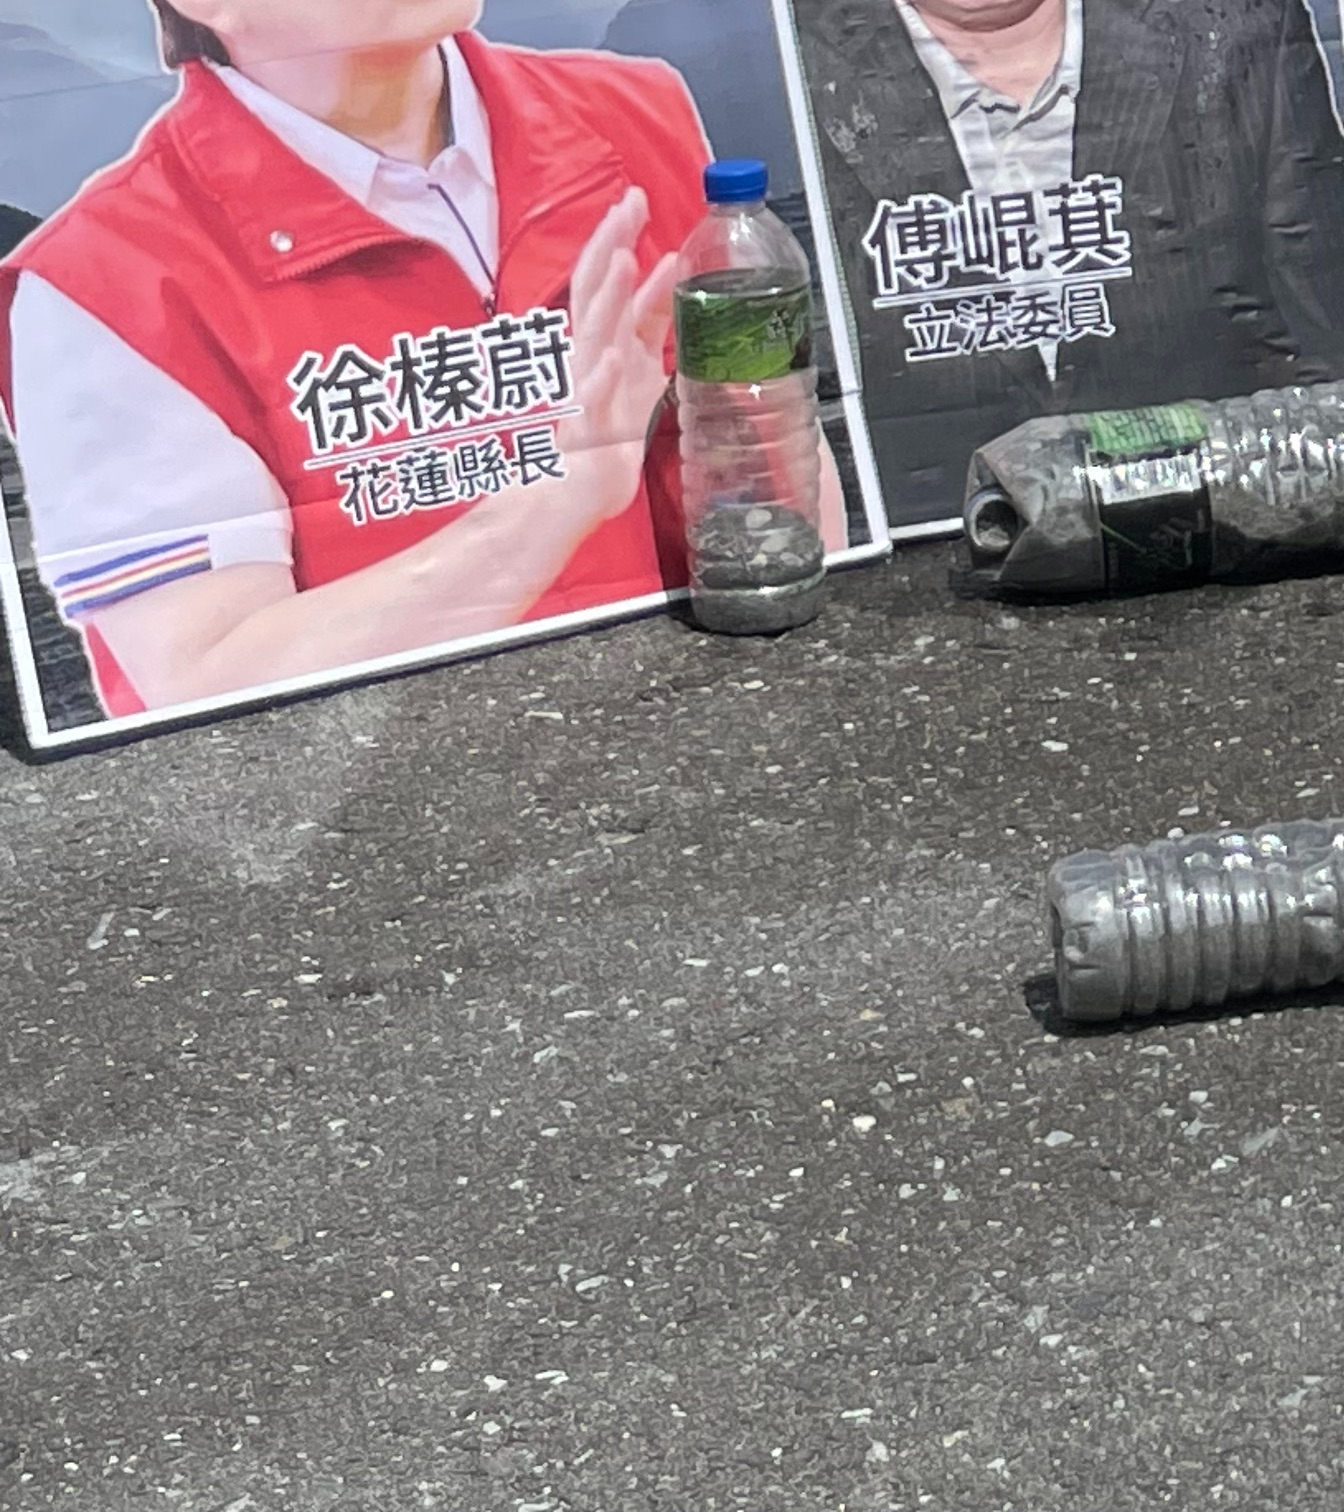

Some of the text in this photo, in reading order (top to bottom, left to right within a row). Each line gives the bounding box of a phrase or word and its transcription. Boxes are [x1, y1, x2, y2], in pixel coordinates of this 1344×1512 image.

[905, 284, 1115, 361] 立法委員
[289, 310, 572, 450] 徐榛蔚
[337, 428, 567, 523] 花蓮縣長
